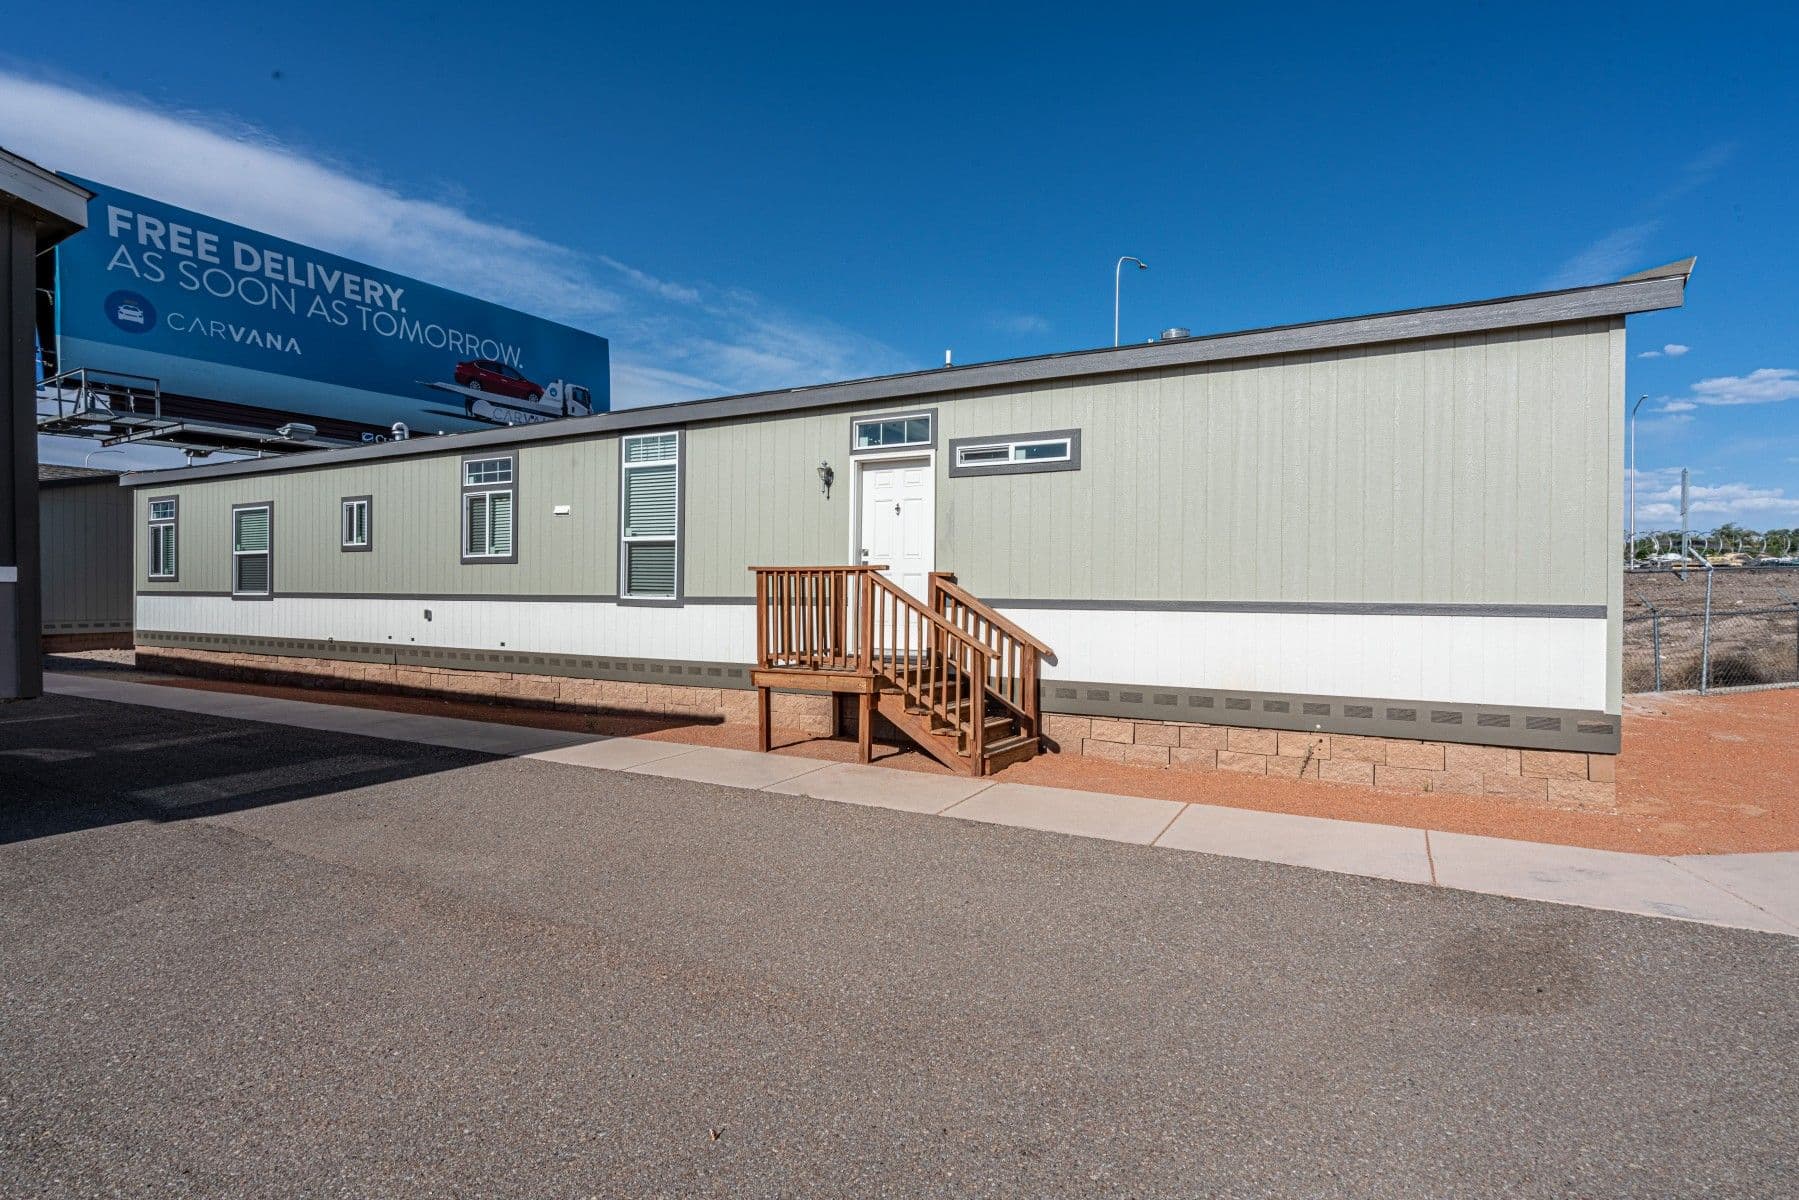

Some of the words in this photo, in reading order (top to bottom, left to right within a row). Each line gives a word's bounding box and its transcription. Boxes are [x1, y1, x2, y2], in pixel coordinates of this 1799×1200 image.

[106, 243, 165, 283] AS
[178, 260, 296, 315] SOON
[306, 294, 349, 326] AS
[356, 305, 524, 369] TOMORROW.
[107, 204, 220, 265] FREE
[233, 240, 405, 314] DELIVERY.
[167, 312, 302, 356] CARVANA
